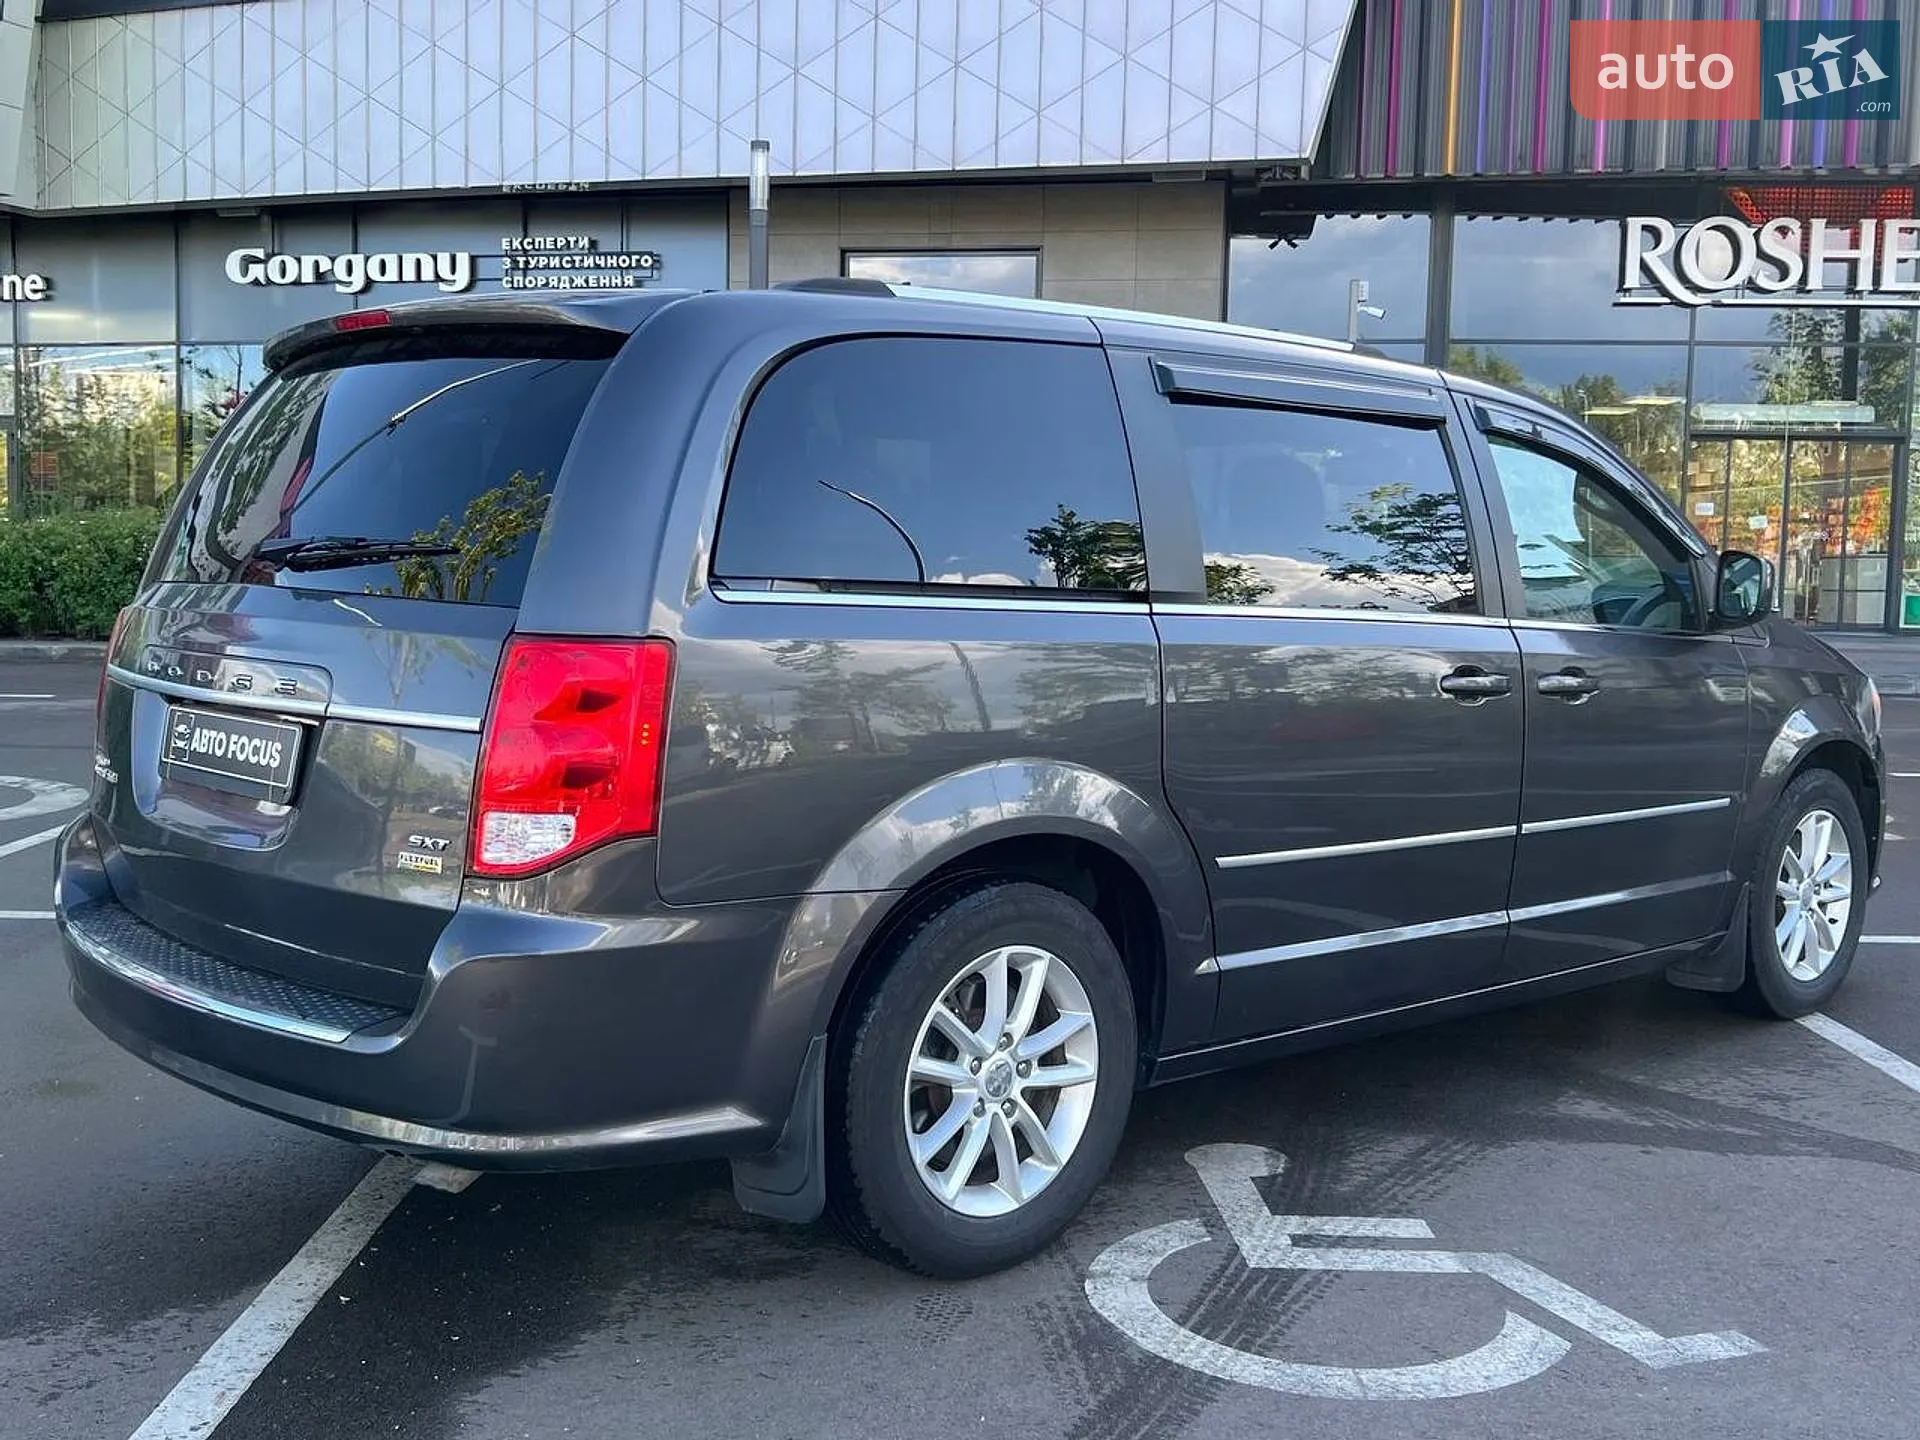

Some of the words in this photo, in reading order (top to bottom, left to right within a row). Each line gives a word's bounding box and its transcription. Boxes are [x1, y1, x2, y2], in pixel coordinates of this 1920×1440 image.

[502, 236, 589, 250] ЕКСПЕРТИ
[225, 248, 471, 293] Gorgany
[516, 255, 653, 269] ТУРИСТИЧНОГО
[1621, 216, 1920, 305] ROSHE
[502, 275, 634, 289] СПОРЯДЖЕННЯ
[147, 659, 298, 696] DODGE
[227, 733, 282, 768] FOCUS
[408, 835, 450, 851] SXT
